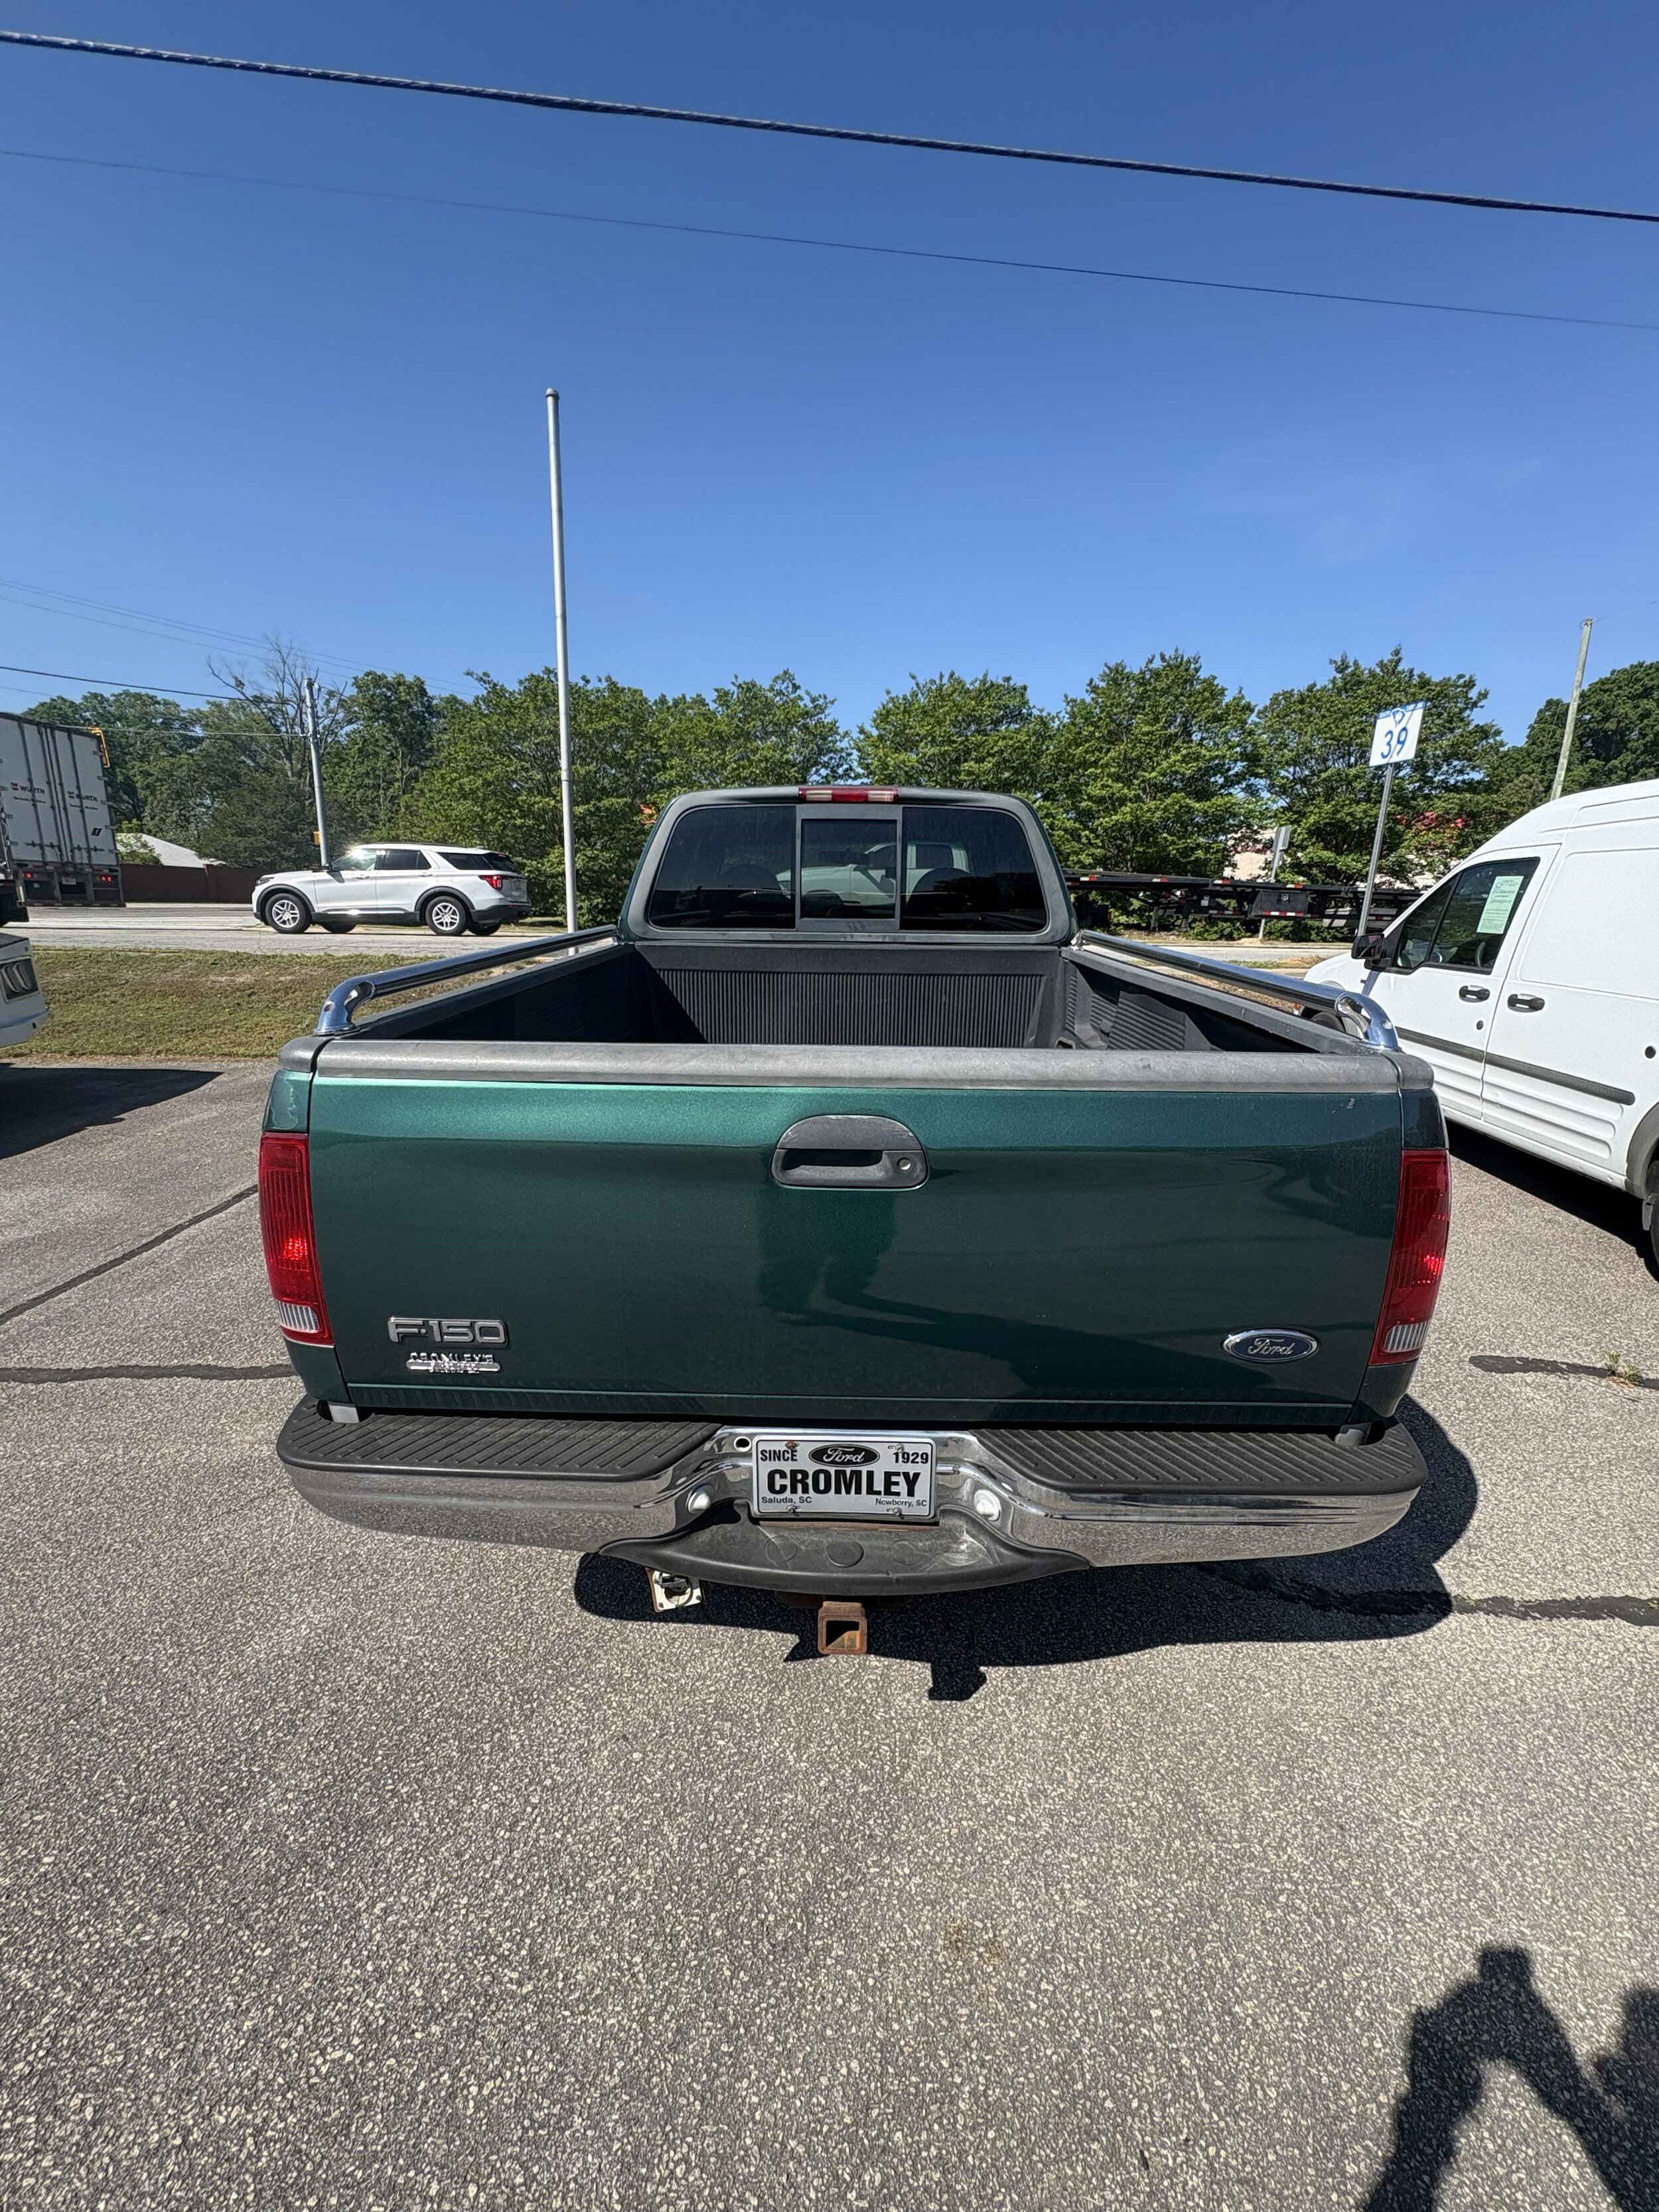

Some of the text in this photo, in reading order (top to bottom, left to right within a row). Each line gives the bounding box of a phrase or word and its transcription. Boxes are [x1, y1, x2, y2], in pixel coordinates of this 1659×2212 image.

[1380, 726, 1408, 759] 39
[388, 1317, 506, 1344] F-150
[1248, 1337, 1296, 1356] Ford
[760, 1446, 929, 1464] SINCE Ford 1929
[767, 1469, 922, 1497] CROMLEY
[875, 1498, 914, 1508] Newberry,
